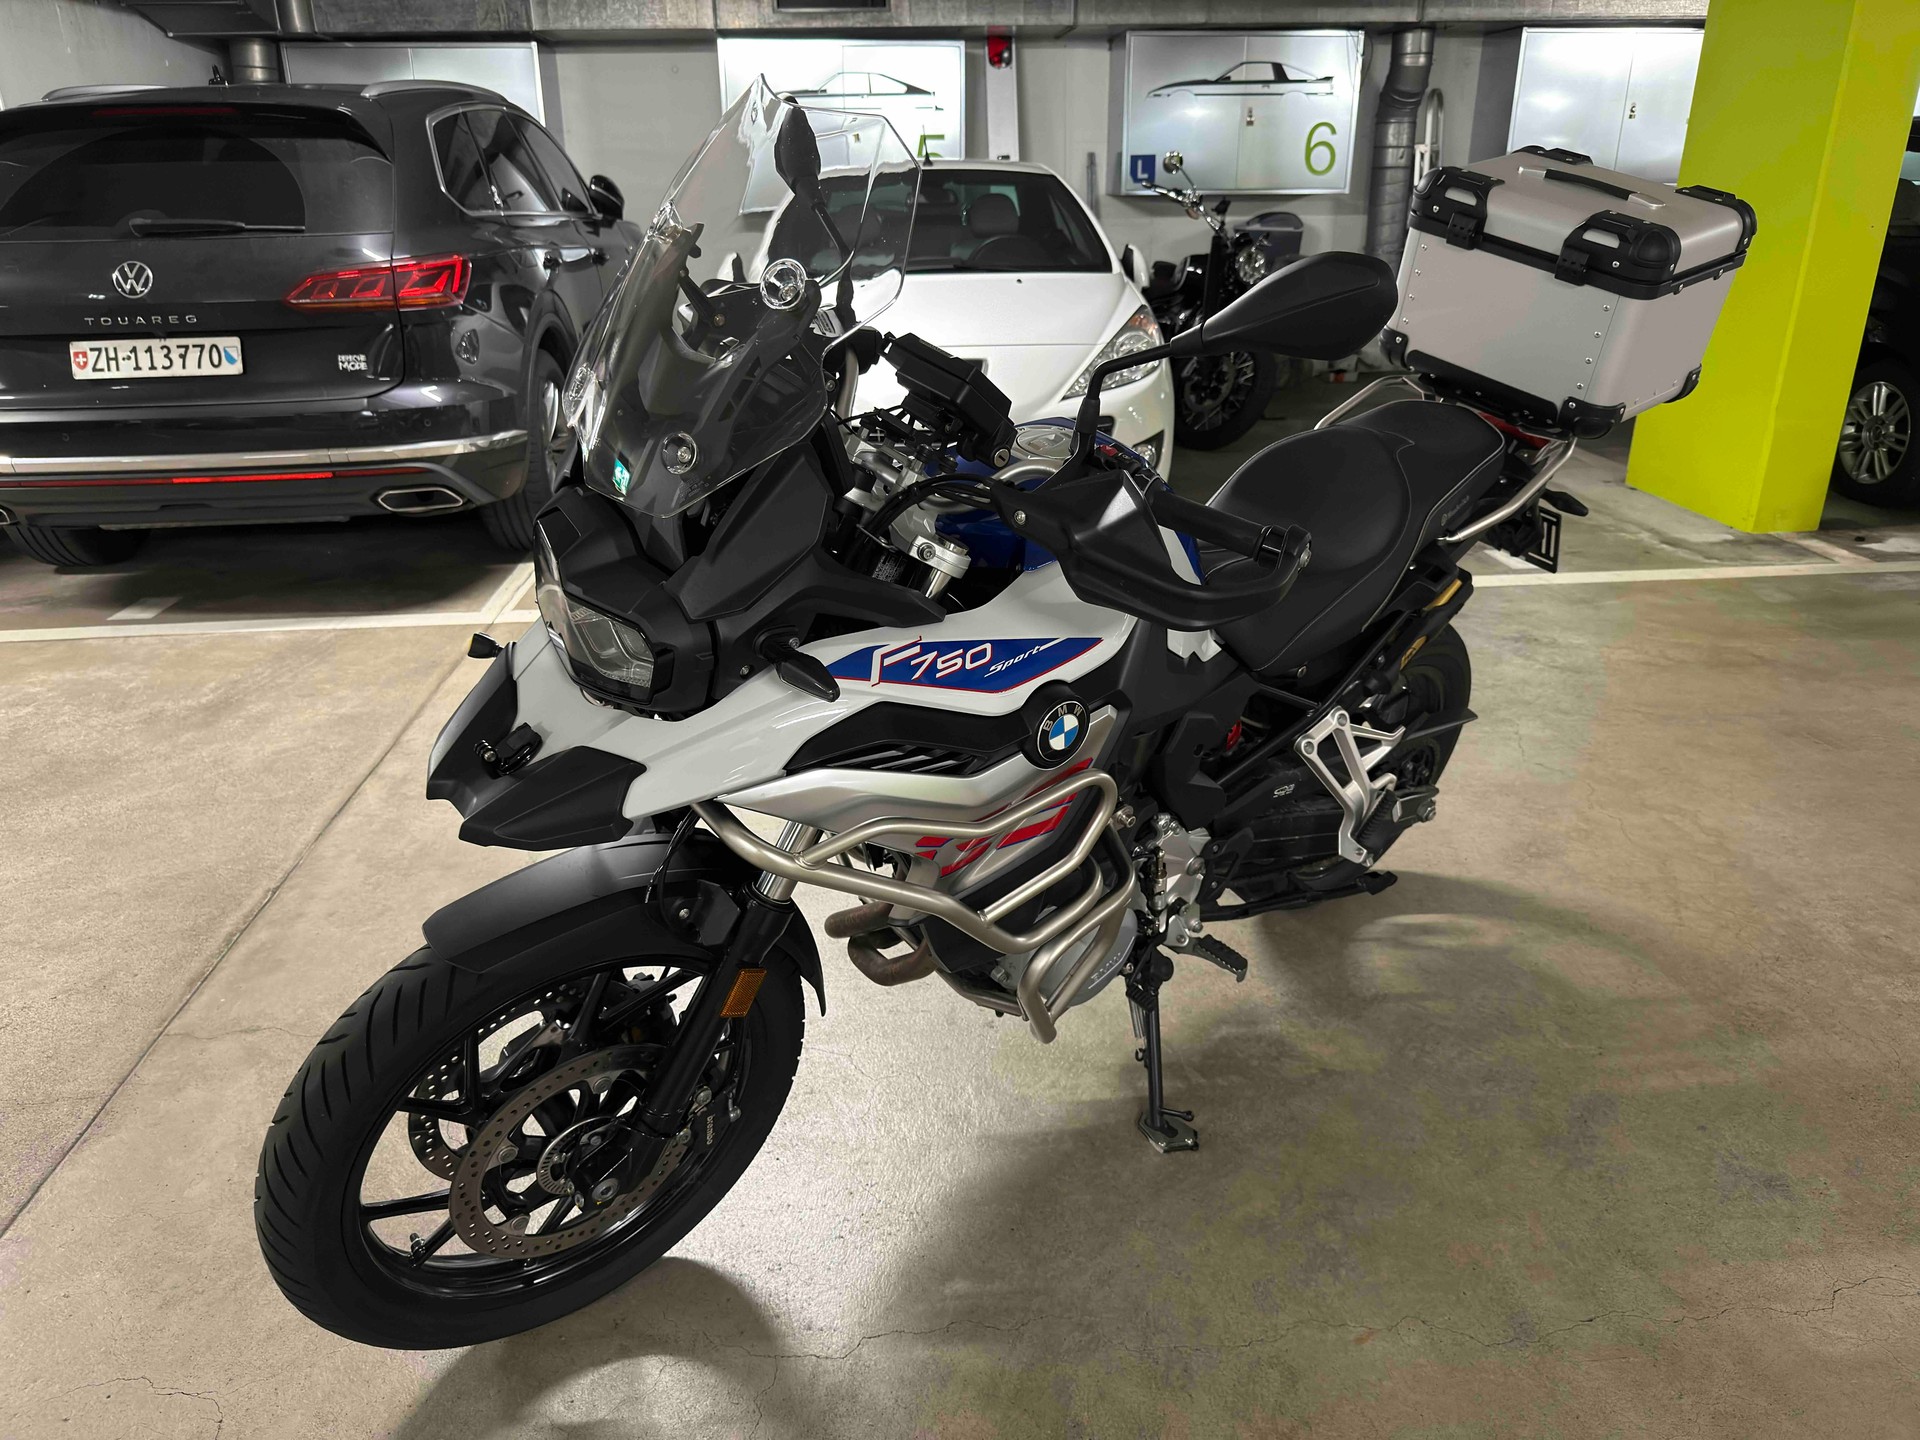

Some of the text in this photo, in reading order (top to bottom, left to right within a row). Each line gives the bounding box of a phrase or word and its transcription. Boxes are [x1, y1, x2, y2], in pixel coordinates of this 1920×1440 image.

[1305, 121, 1337, 177] 6
[1136, 158, 1149, 180] L
[84, 315, 198, 326] TOUAREG
[984, 644, 1043, 679] Sport
[1043, 704, 1083, 732] BMW
